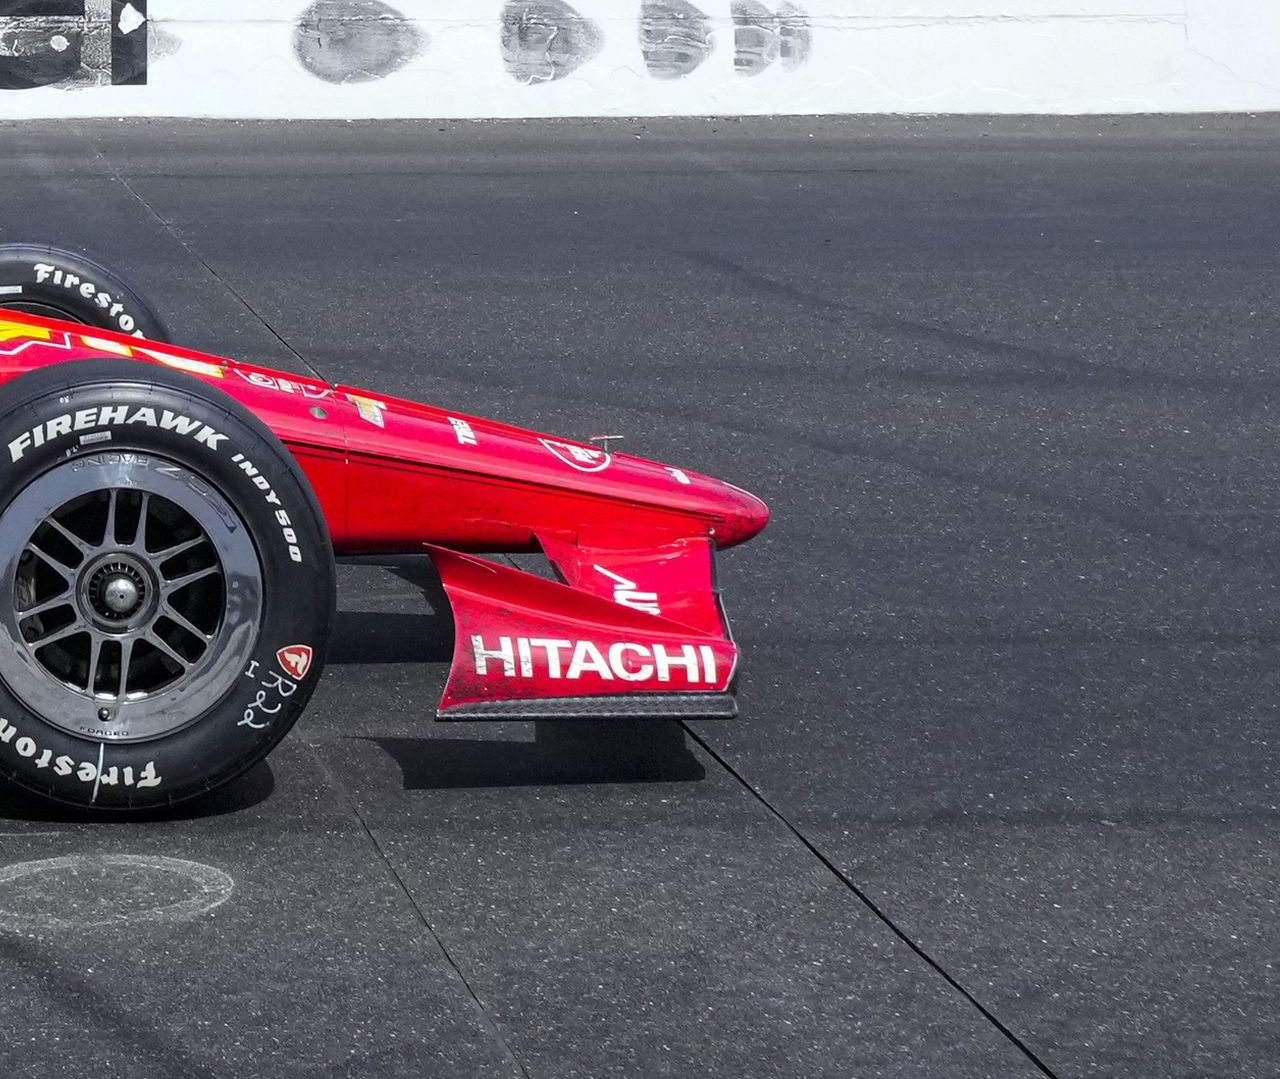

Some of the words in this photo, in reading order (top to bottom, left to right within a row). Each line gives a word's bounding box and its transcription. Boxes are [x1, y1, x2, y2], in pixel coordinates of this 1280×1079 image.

[7, 405, 230, 463] FIREHAWK
[231, 452, 282, 506] INDY
[274, 509, 303, 563] 500
[470, 634, 718, 684] HITACHI
